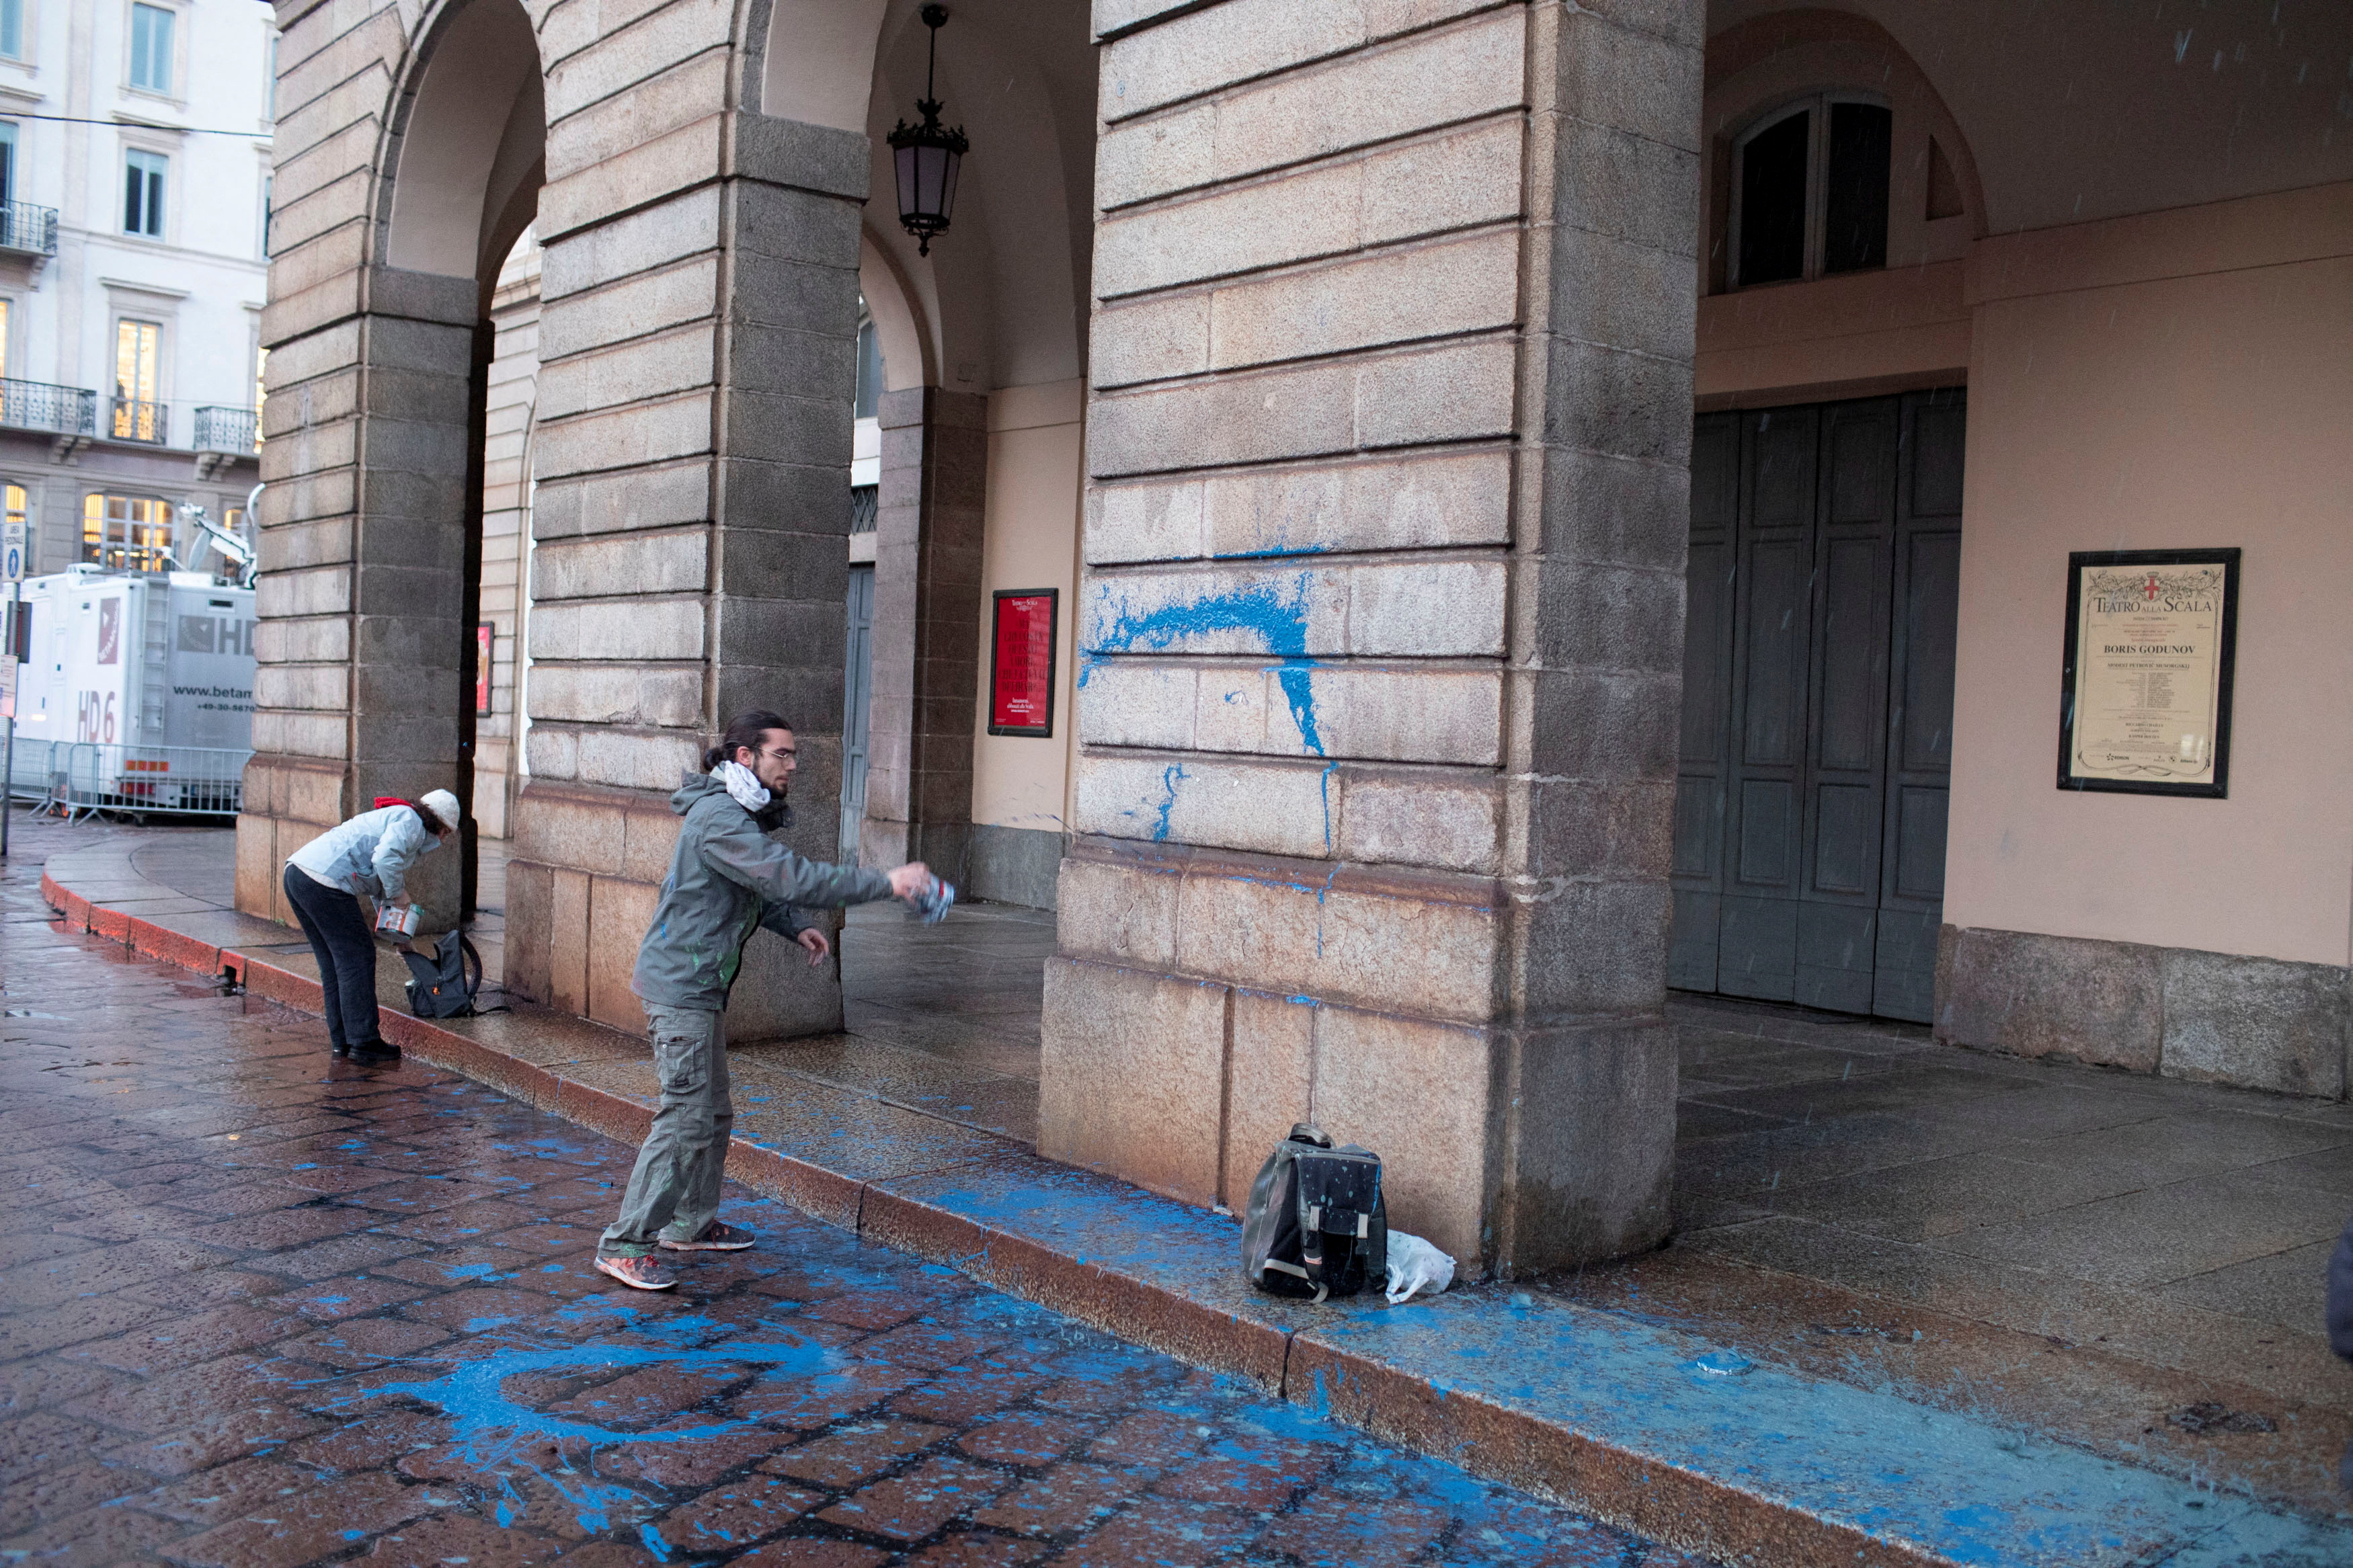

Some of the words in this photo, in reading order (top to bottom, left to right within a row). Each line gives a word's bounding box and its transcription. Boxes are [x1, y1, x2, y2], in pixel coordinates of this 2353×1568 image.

[2093, 597, 2141, 613] TEATRO
[2163, 596, 2212, 612] SCALA
[2104, 645, 2137, 654] BORIS
[2139, 645, 2196, 654] GODUNOV
[77, 690, 100, 743] HD
[104, 690, 116, 744] 6
